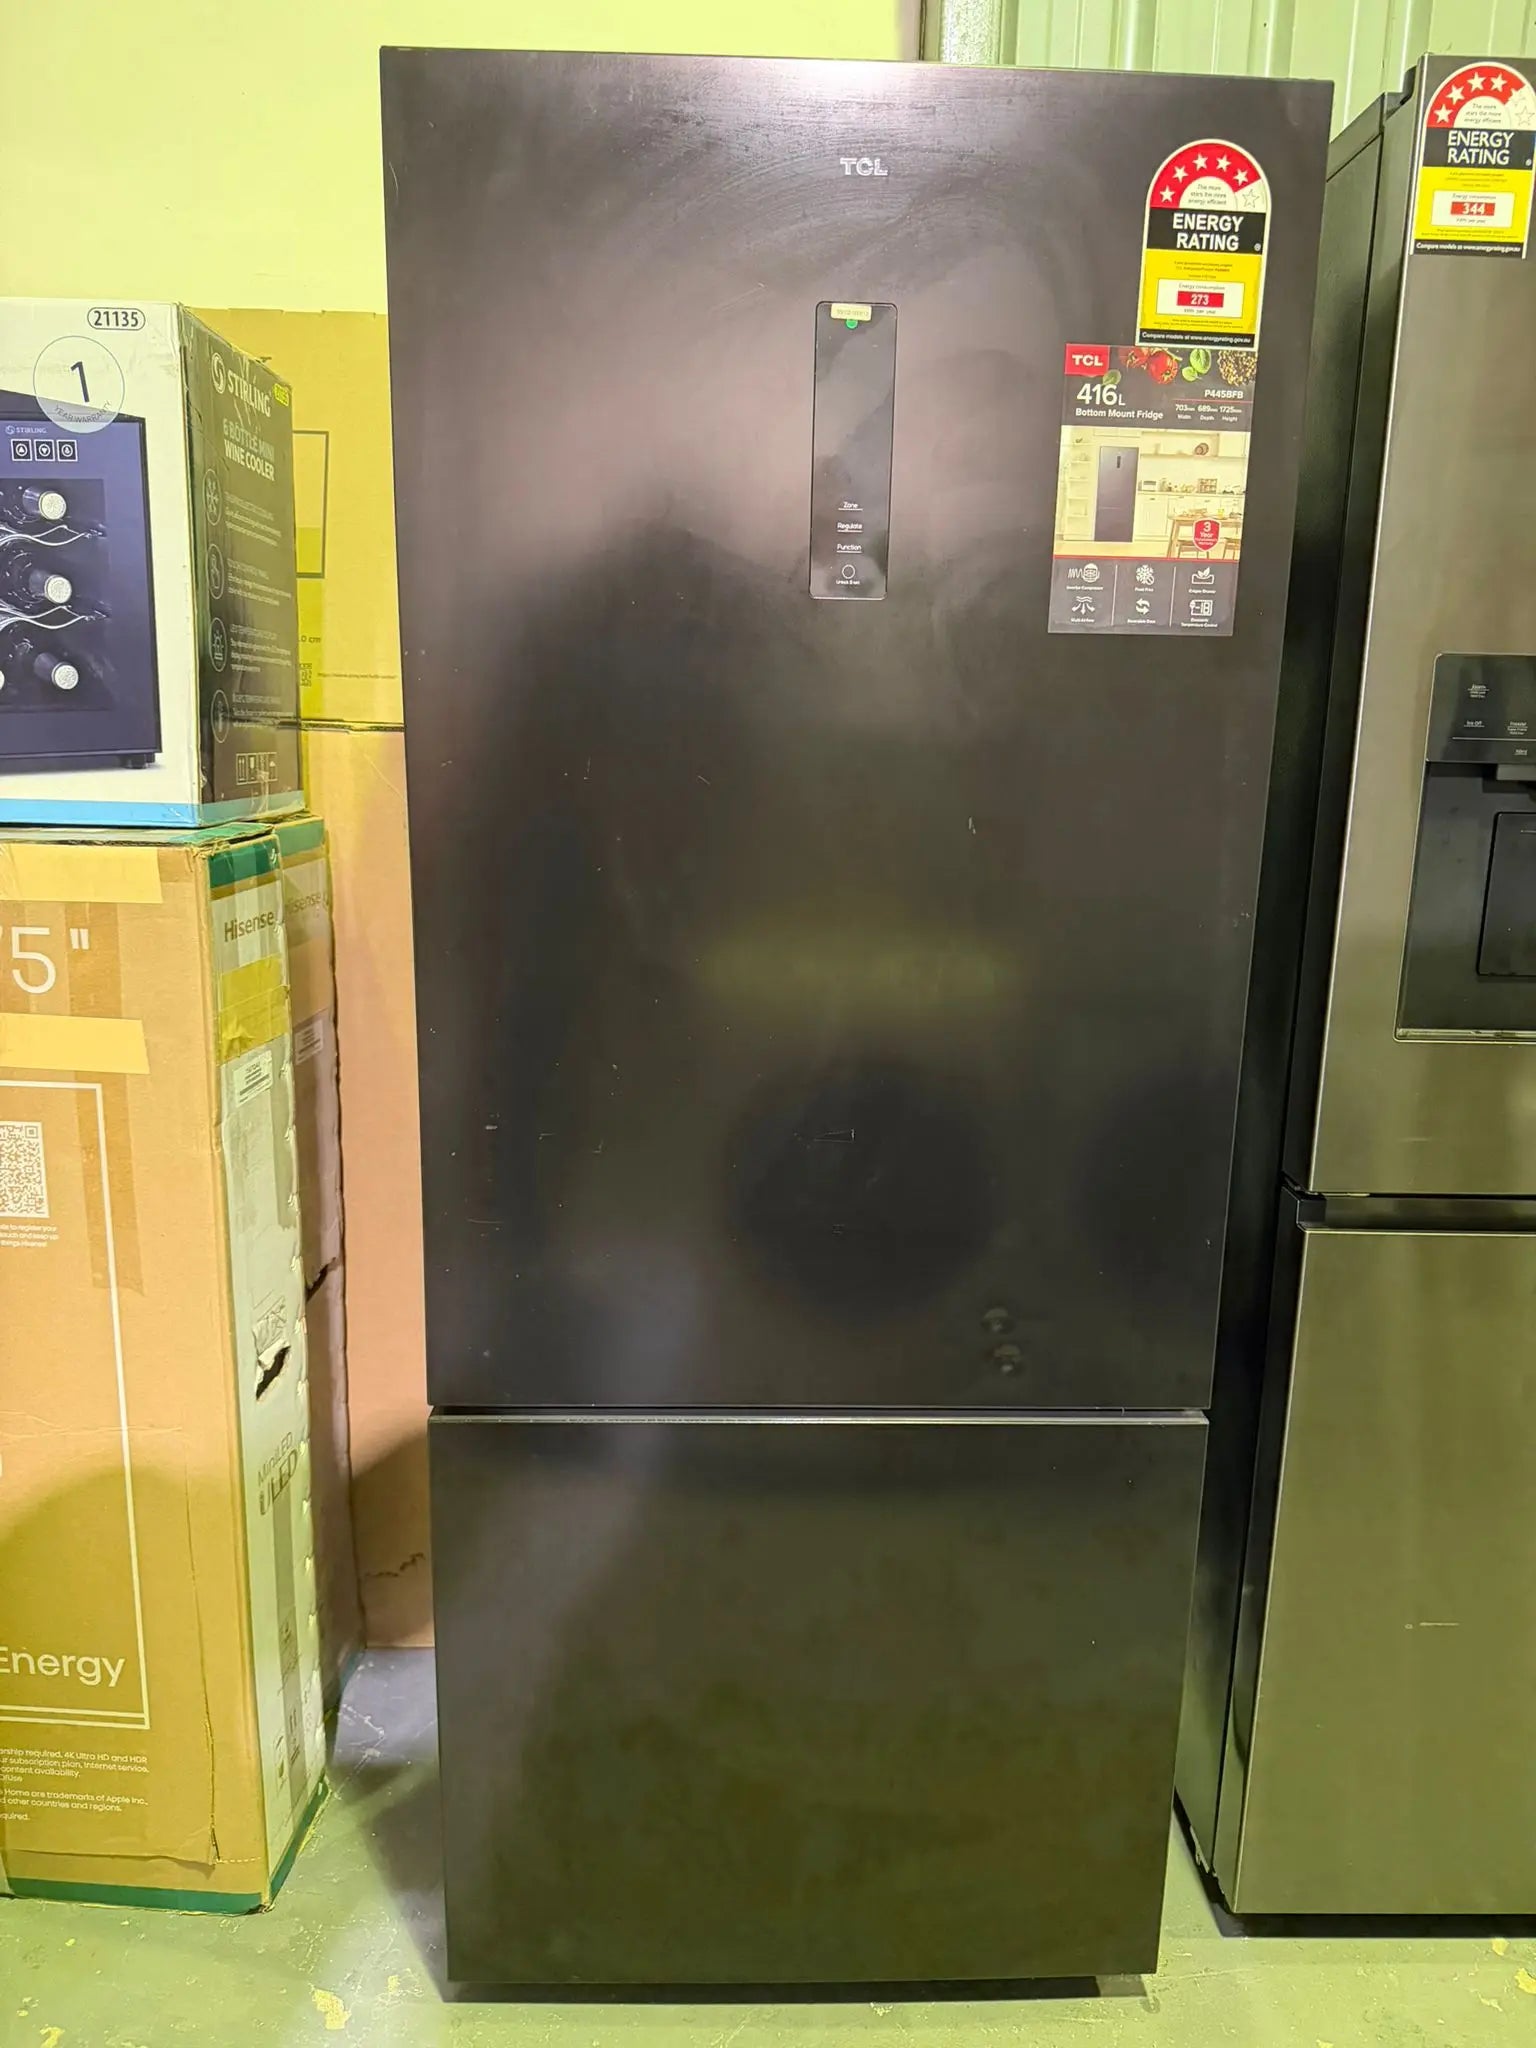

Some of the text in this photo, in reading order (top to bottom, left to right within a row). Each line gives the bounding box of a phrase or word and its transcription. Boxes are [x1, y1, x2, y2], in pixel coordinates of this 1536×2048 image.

[1447, 130, 1515, 151] ENERGY
[1447, 147, 1510, 166] RATING
[840, 157, 889, 177] TCL
[1462, 202, 1485, 215] 344
[1172, 212, 1244, 233] ENERGY
[1176, 232, 1240, 252] RATING
[1190, 294, 1209, 306] 273
[94, 310, 139, 327] 21135
[1072, 354, 1103, 367] TCL
[70, 361, 90, 403] 1
[227, 369, 271, 418] STIRLING
[1075, 407, 1164, 420] Bottom Mount Fridge
[15, 426, 47, 434] STIRLING
[224, 438, 275, 481] WINE COOLER
[843, 501, 859, 509] Zone
[837, 522, 863, 532] Regulate
[1203, 521, 1212, 533] 3
[837, 543, 862, 551] Function
[224, 911, 275, 942] Hisense
[259, 1449, 298, 1516] ULED
[75, 1751, 96, 1760] Ultra
[97, 1753, 110, 1761] HD
[111, 1754, 129, 1762] and
[129, 1755, 148, 1764] HDR
[4, 1788, 30, 1797] Home
[31, 1790, 46, 1798] are
[46, 1791, 95, 1800] trademarks
[106, 1795, 131, 1804] Apple
[30, 1800, 70, 1809] countries
